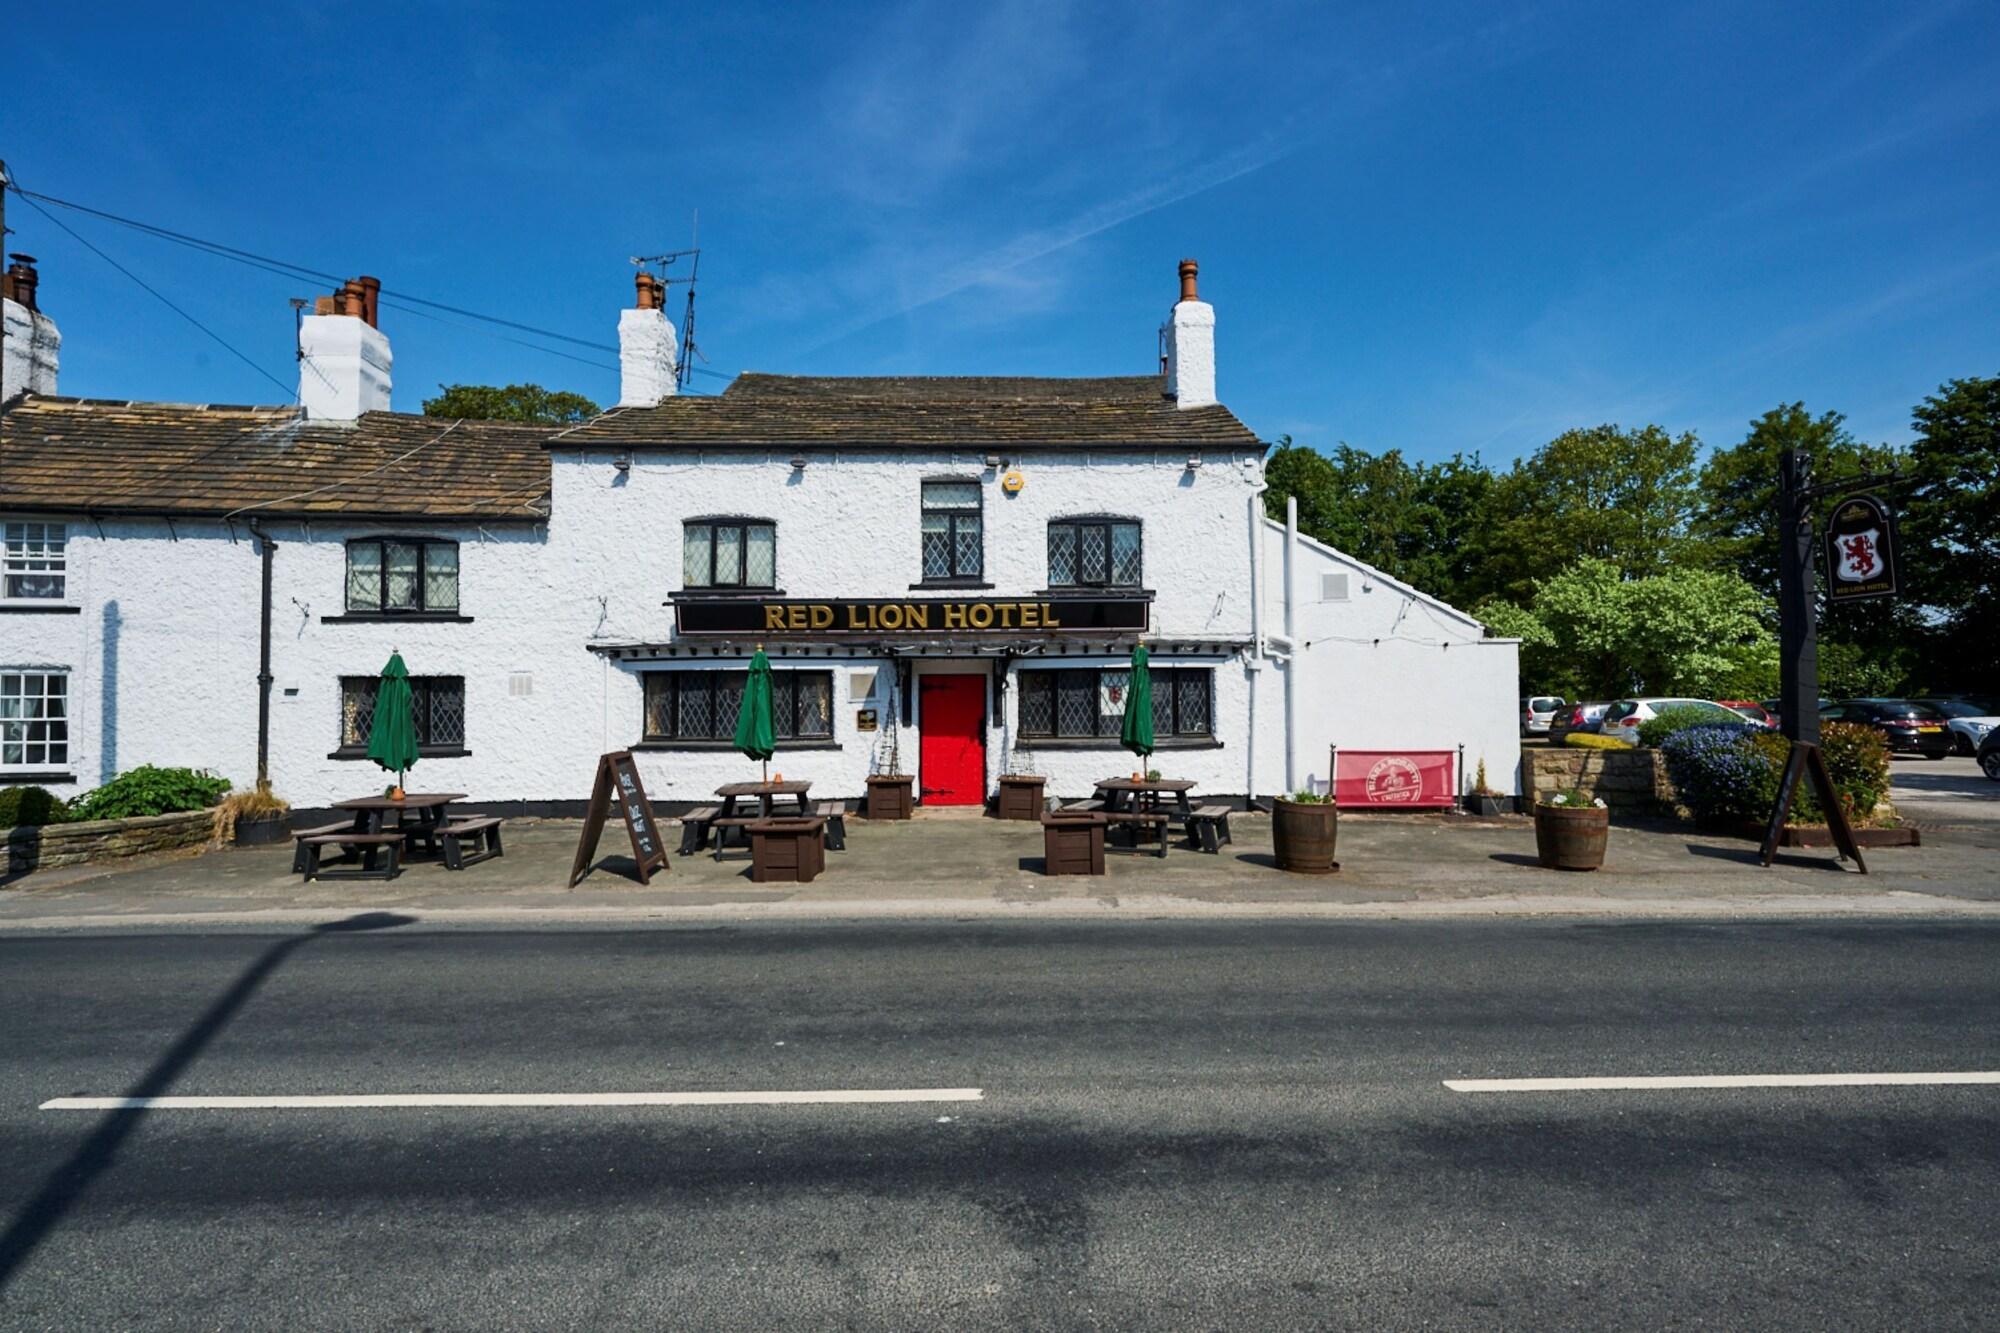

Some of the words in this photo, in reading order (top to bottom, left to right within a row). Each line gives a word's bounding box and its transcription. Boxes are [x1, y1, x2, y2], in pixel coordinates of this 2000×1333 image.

[764, 605, 834, 629] RED
[847, 604, 928, 628] LION
[943, 603, 1060, 627] HOTEL
